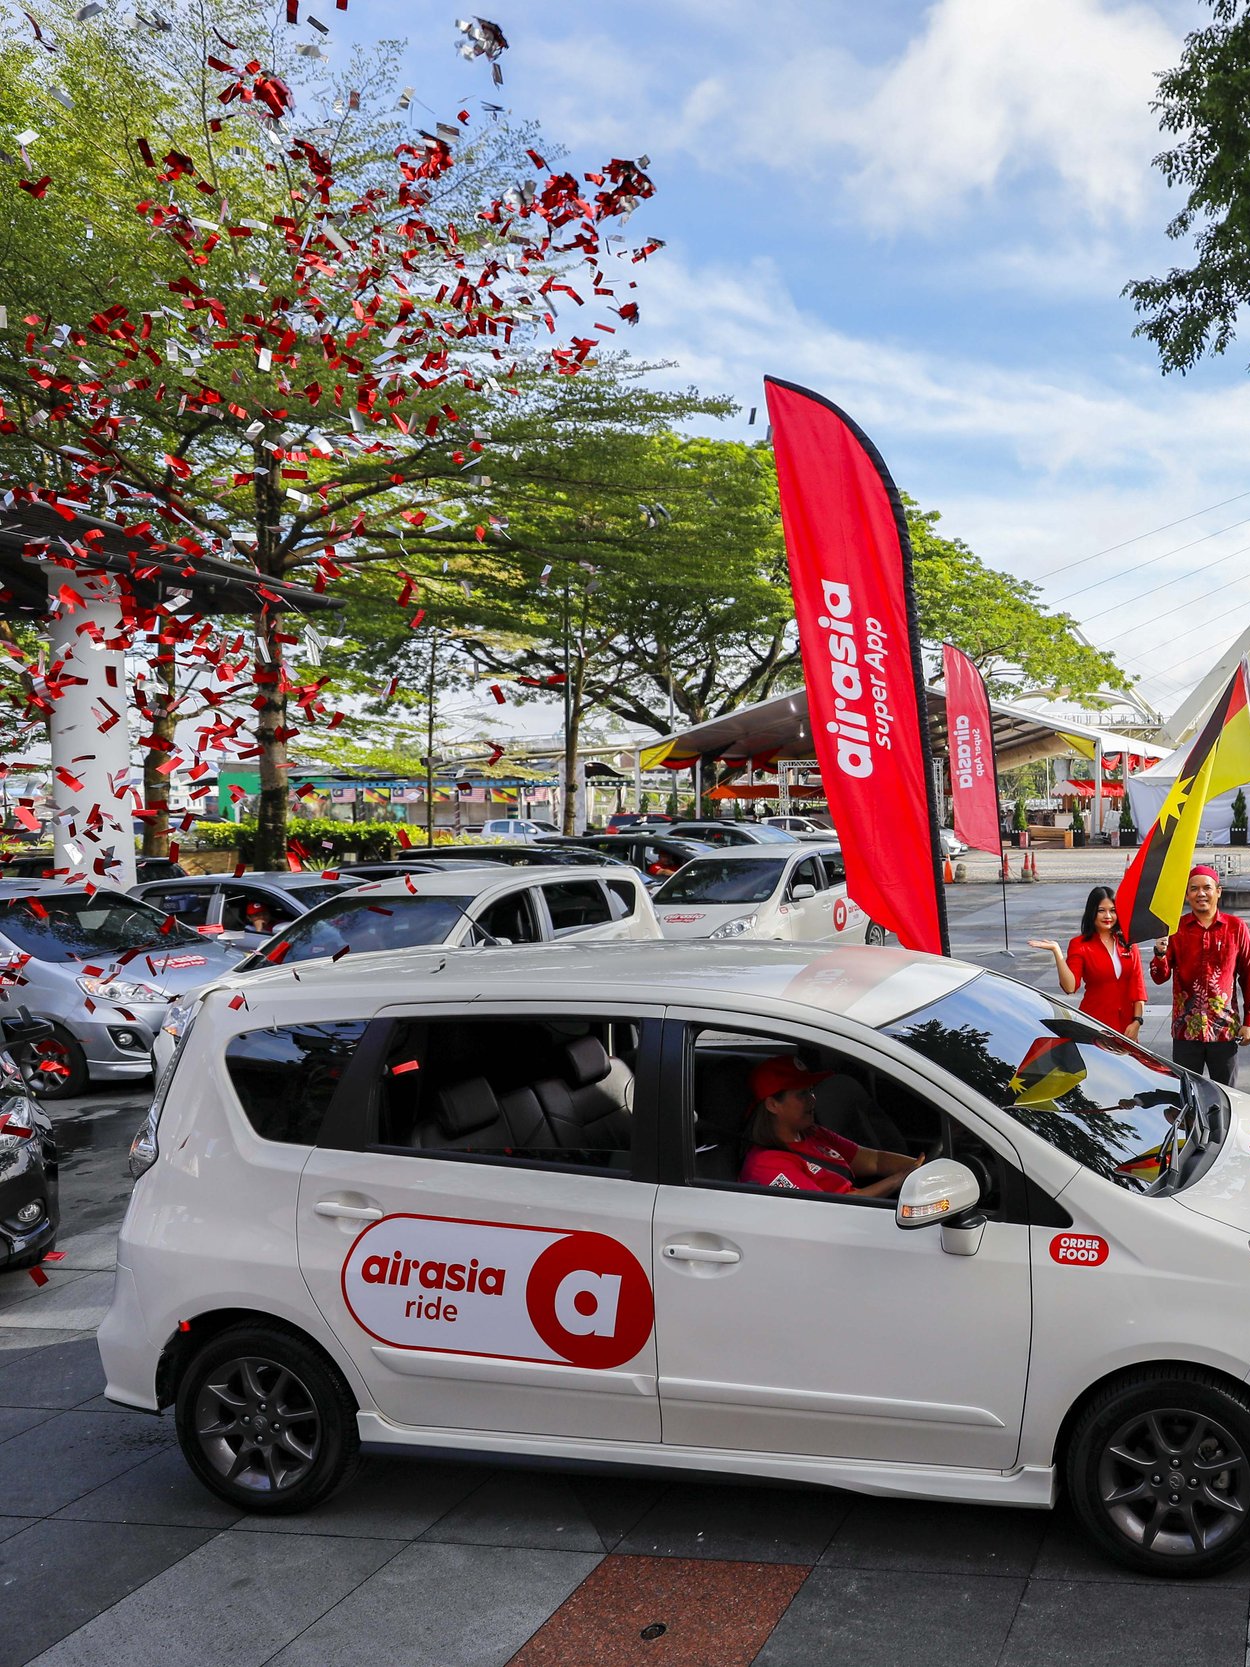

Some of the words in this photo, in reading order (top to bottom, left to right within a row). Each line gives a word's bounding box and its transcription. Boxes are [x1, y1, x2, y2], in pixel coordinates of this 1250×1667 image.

[864, 617, 888, 673] App
[817, 579, 873, 779] airasia
[1058, 1248, 1099, 1261] FOOD
[1060, 1237, 1100, 1249] ORDER
[361, 1250, 506, 1296] airasia
[405, 1295, 458, 1322] ride
[554, 1269, 623, 1338] a
